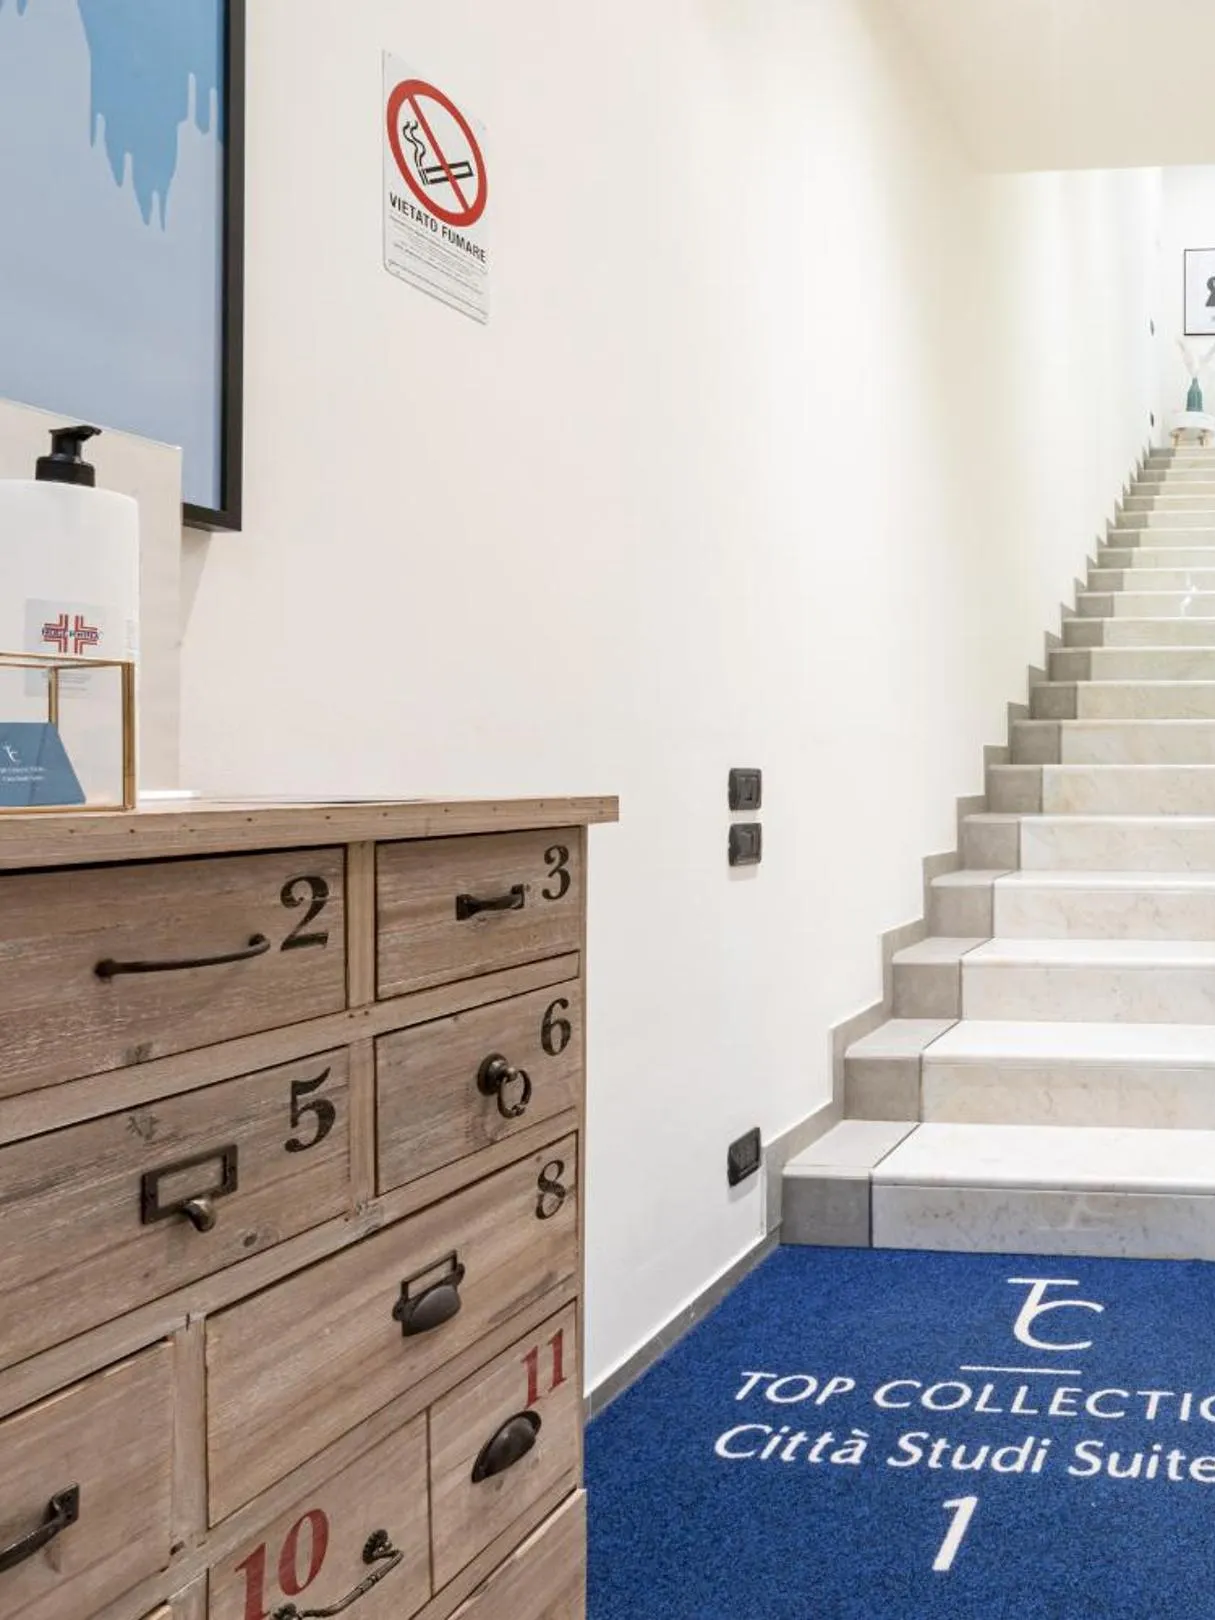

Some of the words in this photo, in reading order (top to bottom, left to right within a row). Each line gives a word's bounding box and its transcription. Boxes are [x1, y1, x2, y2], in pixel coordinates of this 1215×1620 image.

[389, 191, 438, 231] VIETATO
[441, 224, 487, 263] FUMARE
[542, 844, 571, 901] 3
[280, 875, 330, 951] 2
[541, 998, 571, 1056] 6
[285, 1066, 336, 1153] 5
[536, 1160, 566, 1220] 8
[520, 1329, 566, 1409] 11
[734, 1371, 856, 1405] TOP
[713, 1422, 869, 1467] Città
[886, 1431, 1051, 1476] Studi
[234, 1508, 330, 1620] 10
[931, 1495, 979, 1573] 1
